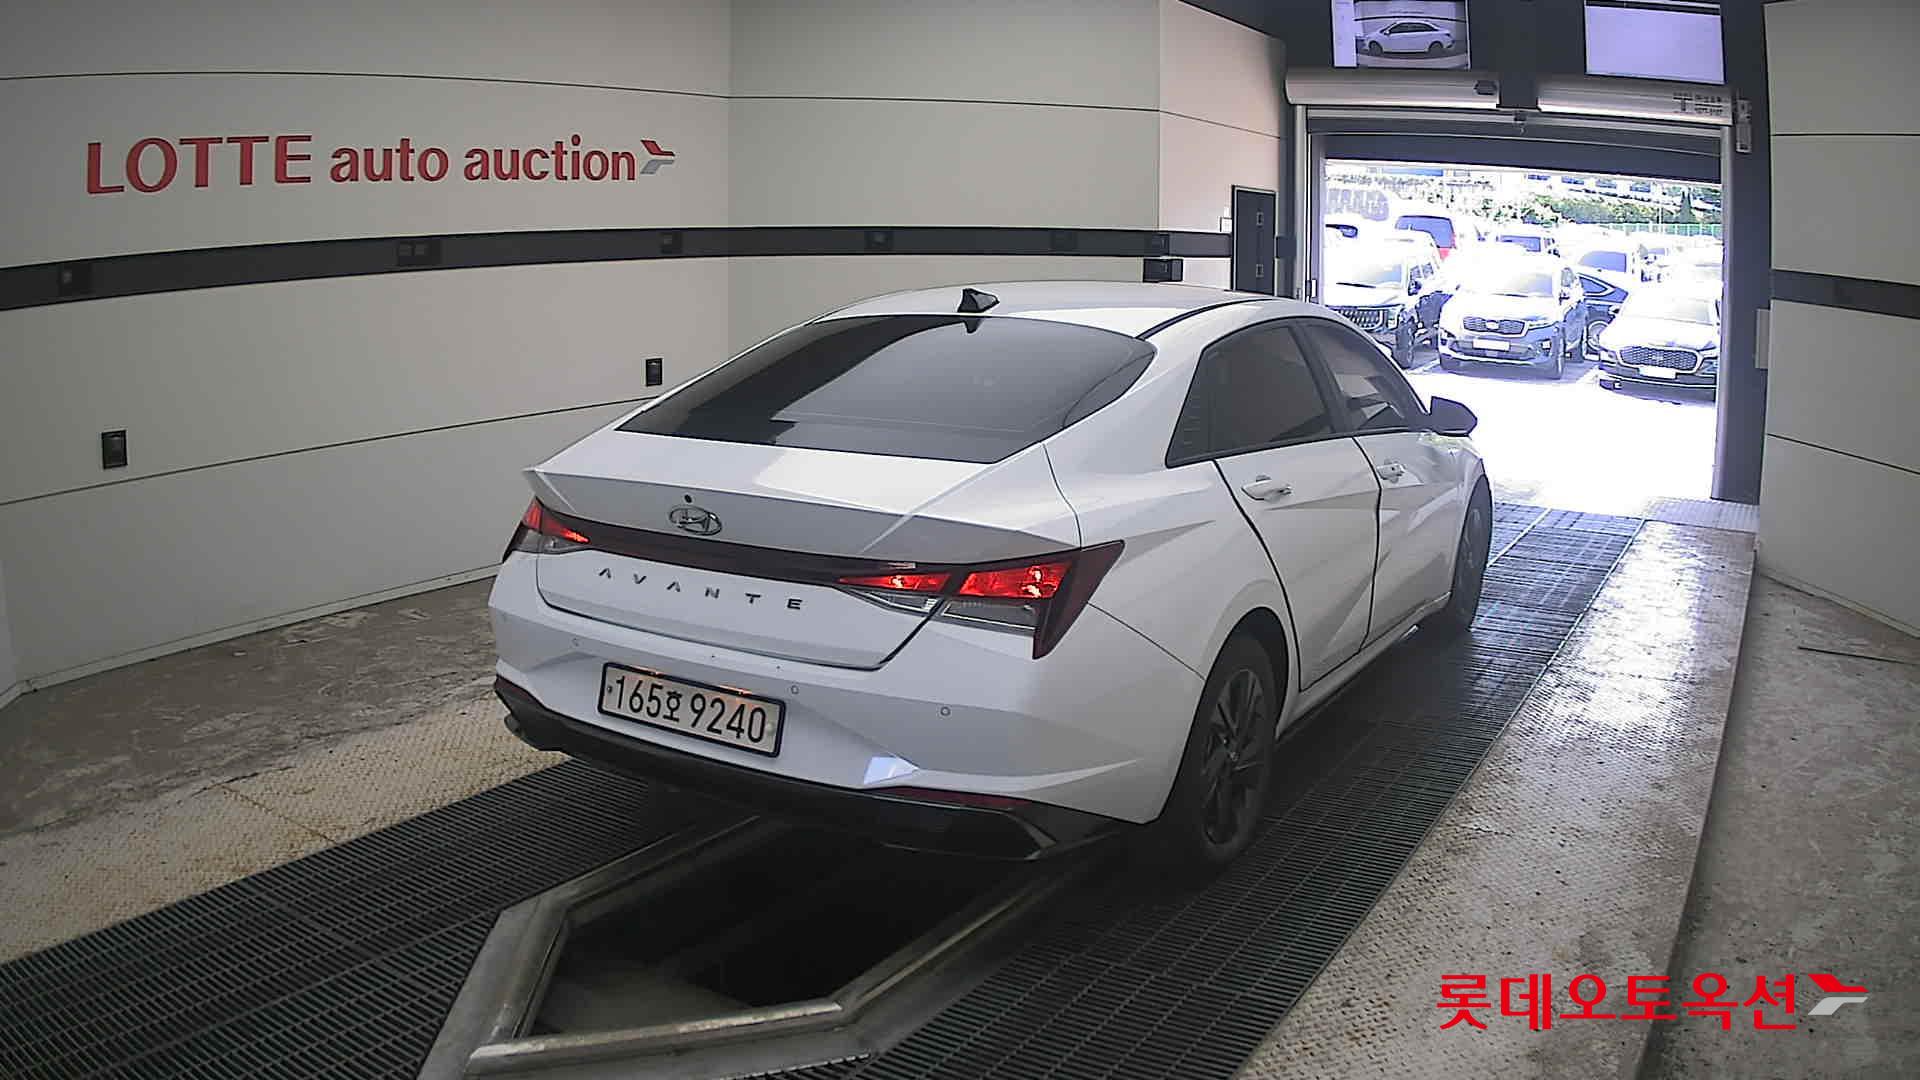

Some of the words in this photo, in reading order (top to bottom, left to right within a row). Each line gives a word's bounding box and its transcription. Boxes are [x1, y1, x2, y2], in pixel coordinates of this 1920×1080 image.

[86, 134, 312, 194] LOTTE
[329, 137, 449, 183] auto
[463, 133, 637, 182] auction
[598, 567, 803, 610] AVANTE
